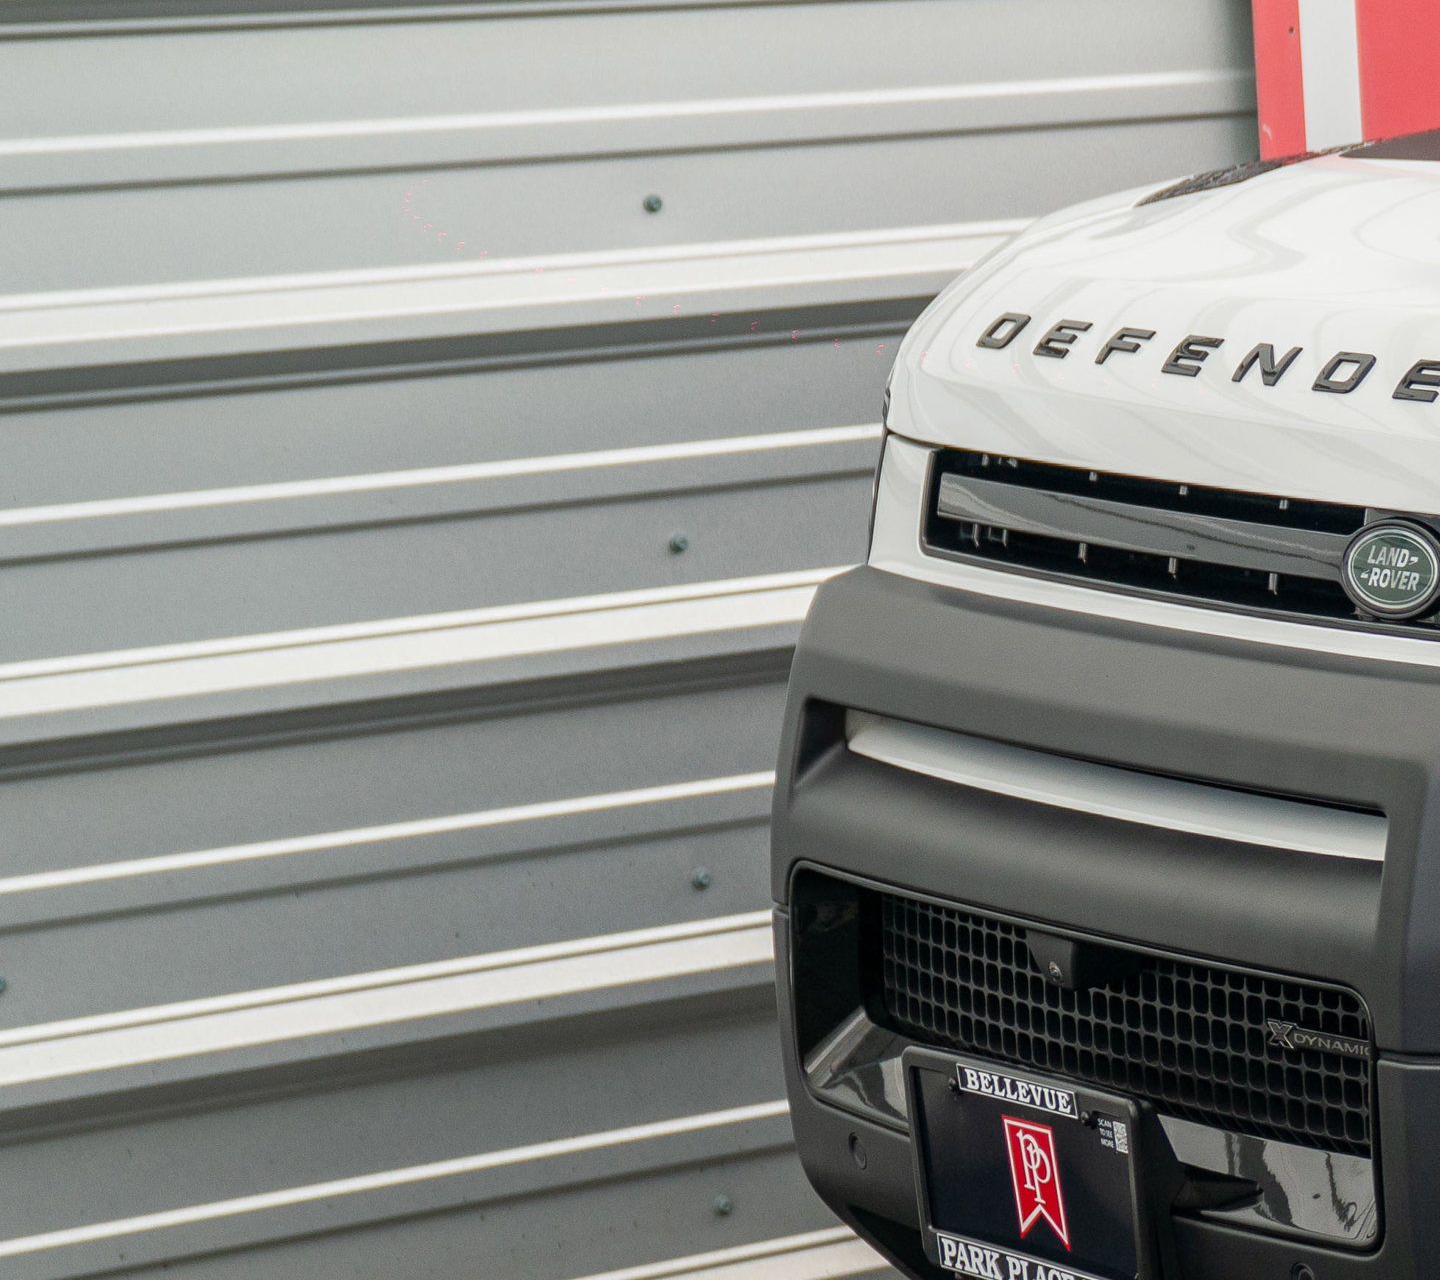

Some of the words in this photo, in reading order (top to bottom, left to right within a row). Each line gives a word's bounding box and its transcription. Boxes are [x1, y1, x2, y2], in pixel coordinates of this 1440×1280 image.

[1367, 544, 1410, 568] LAND
[1368, 567, 1420, 591] ROVER
[964, 1068, 1071, 1114] BELLEVUE
[940, 1237, 1001, 1280] PARK
